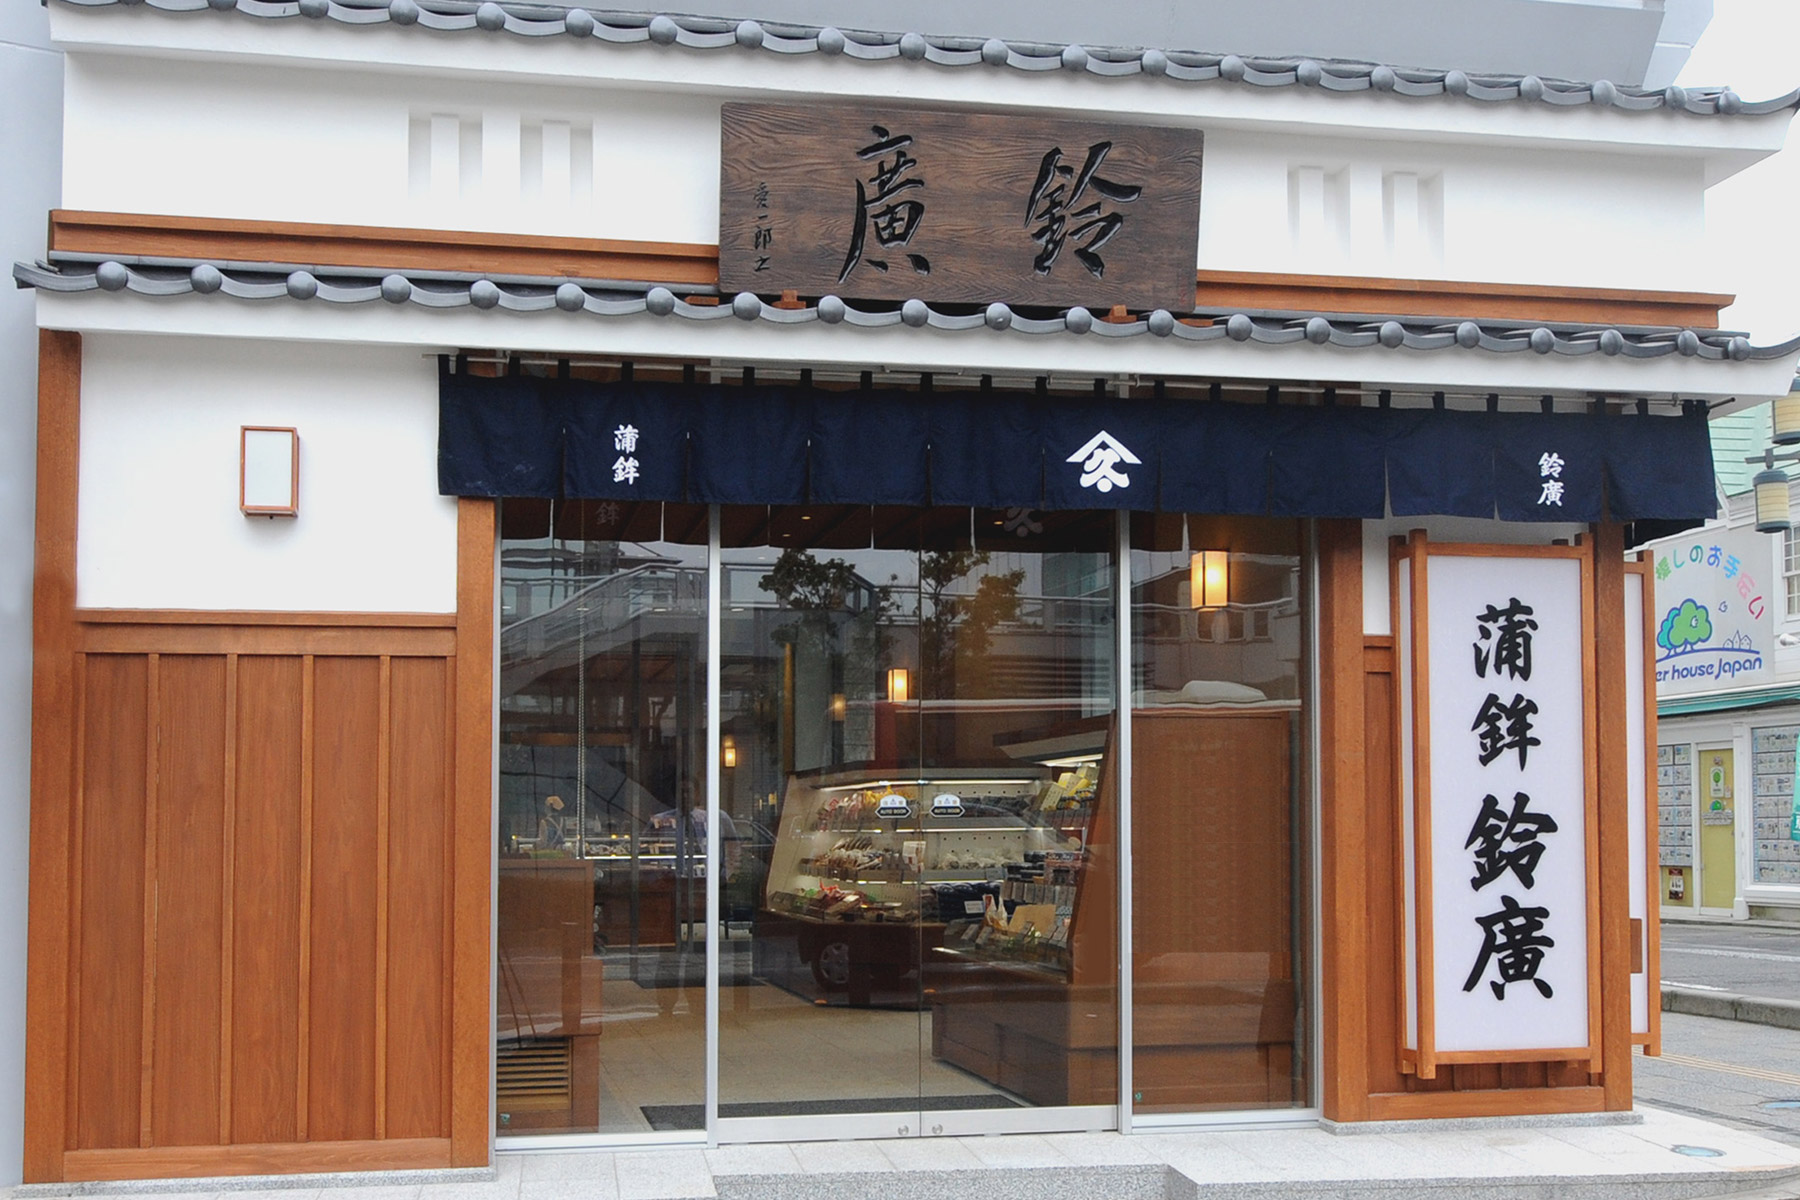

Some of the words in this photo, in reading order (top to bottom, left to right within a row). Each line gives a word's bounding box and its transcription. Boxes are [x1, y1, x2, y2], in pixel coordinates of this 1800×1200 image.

[612, 424, 640, 485] 蒲鉾
[1537, 452, 1565, 507] 鈴廣
[1671, 664, 1714, 680] house
